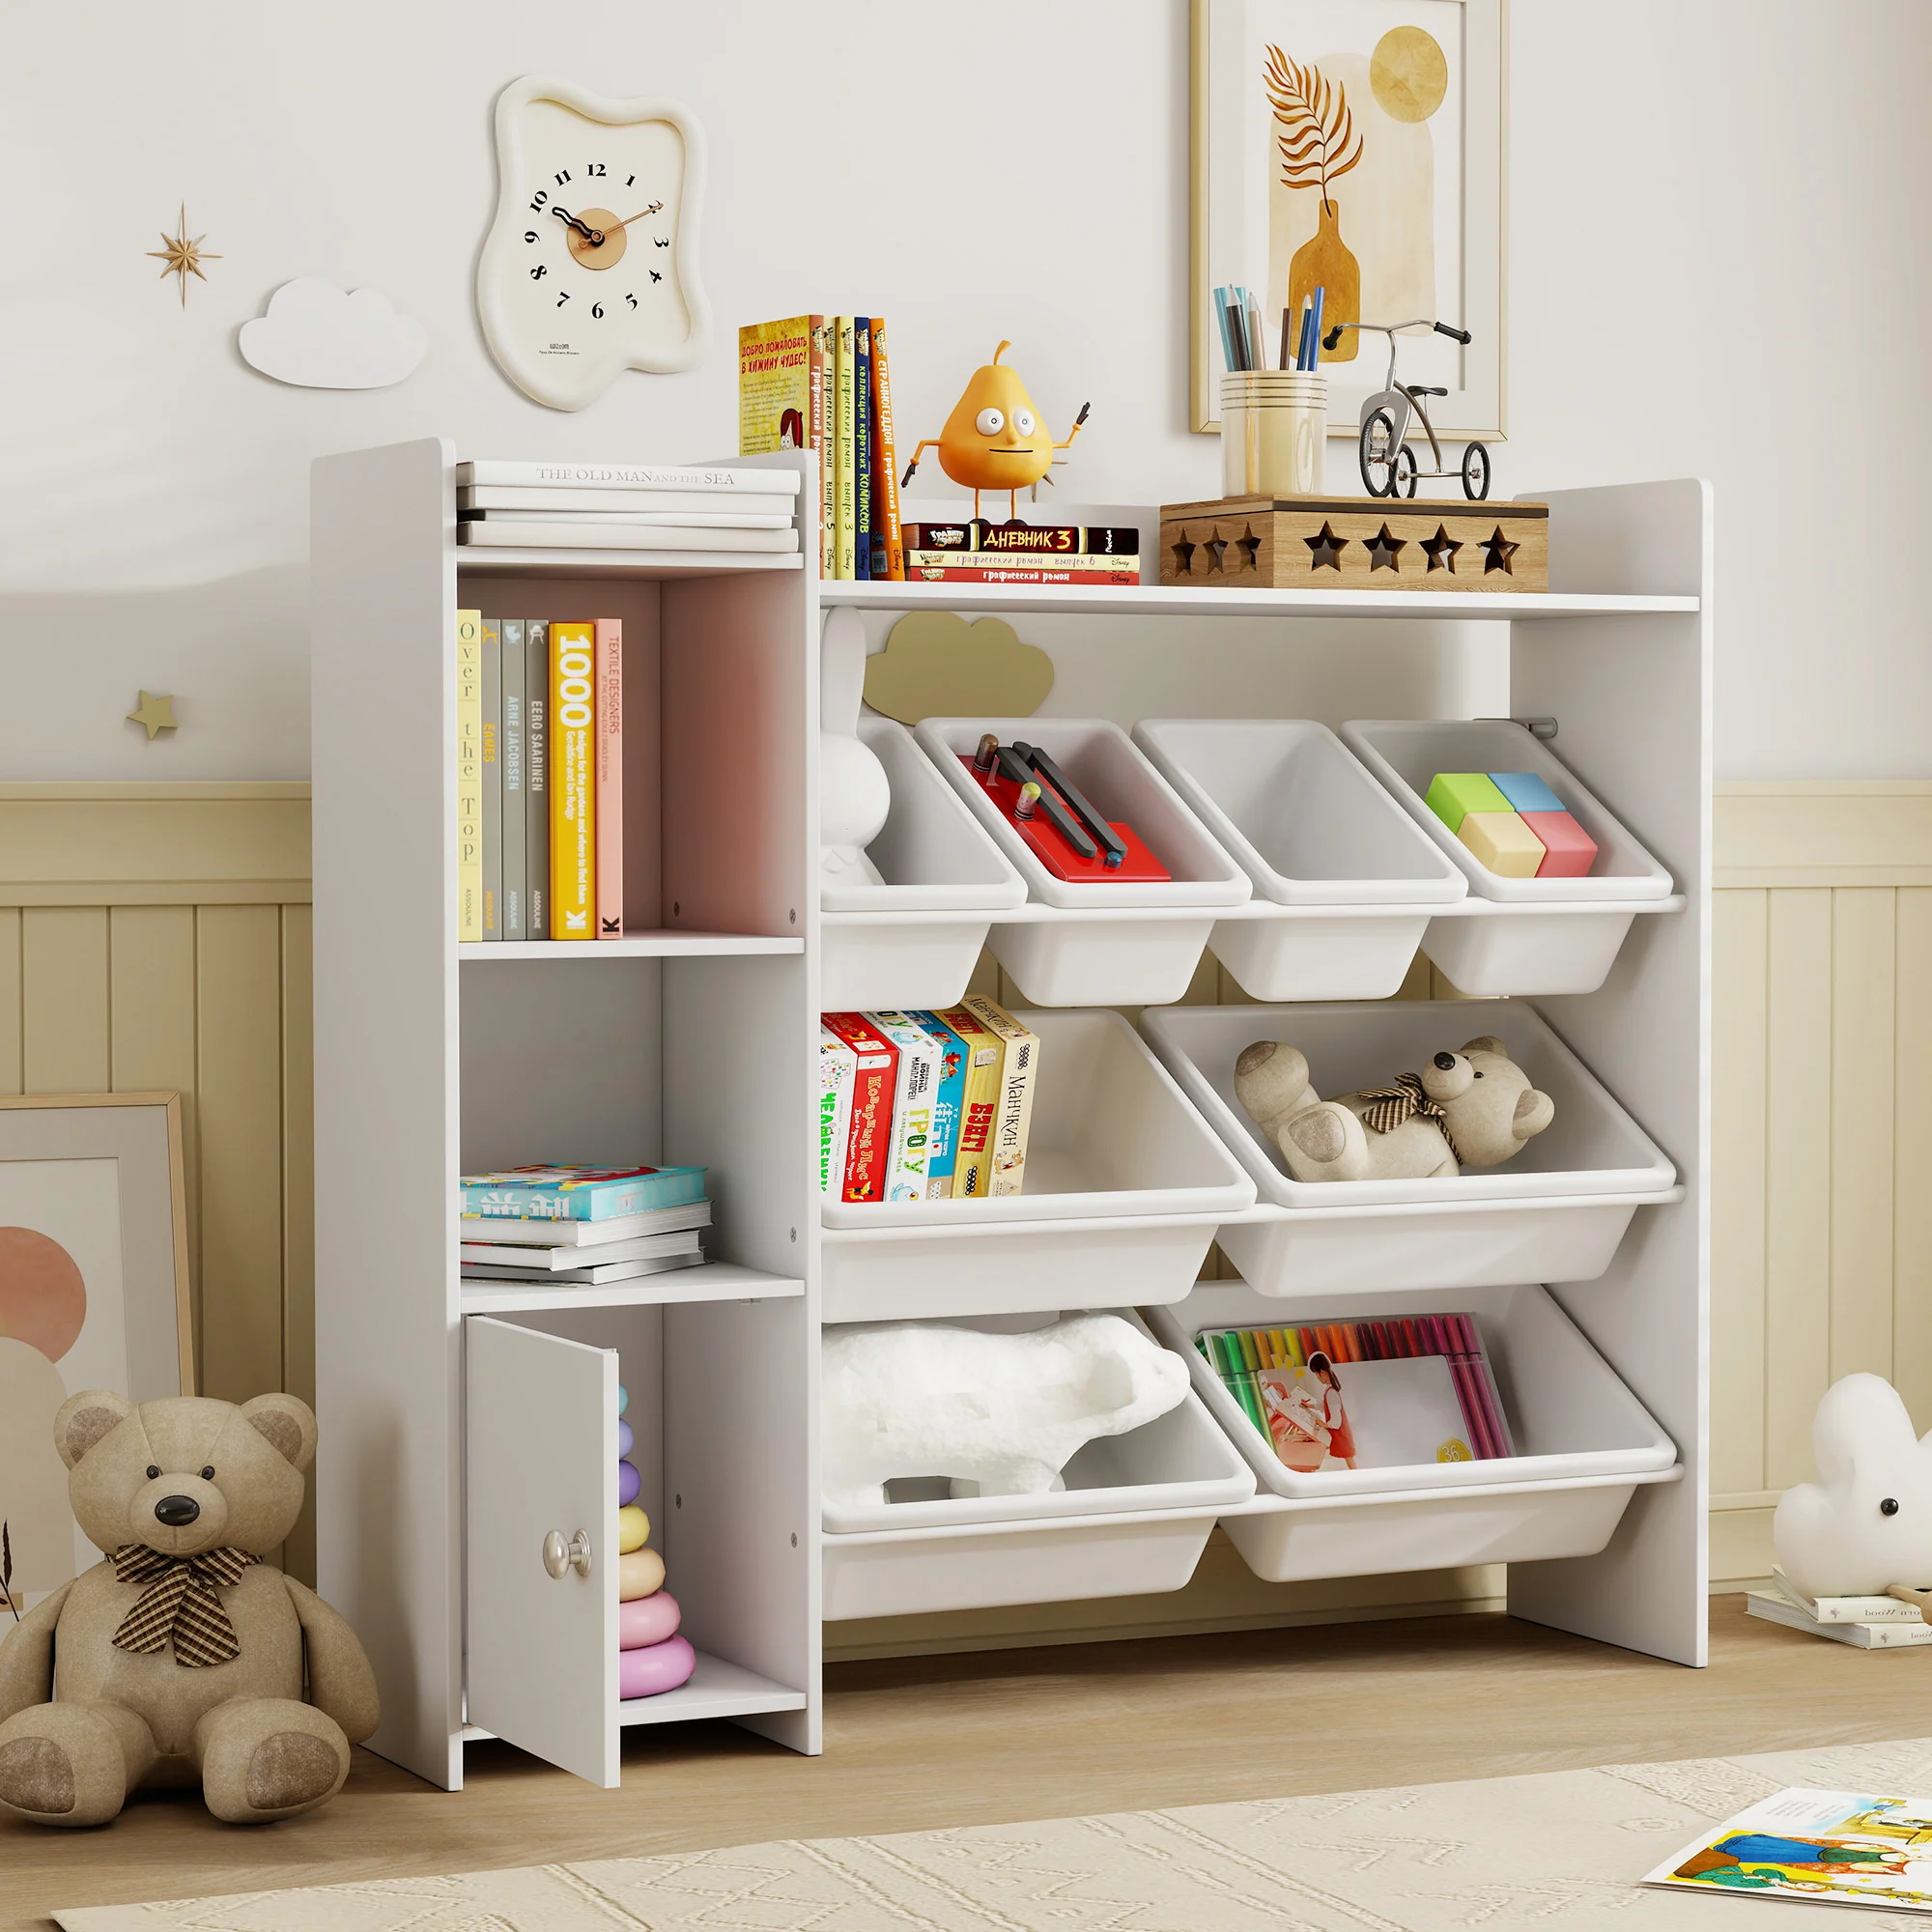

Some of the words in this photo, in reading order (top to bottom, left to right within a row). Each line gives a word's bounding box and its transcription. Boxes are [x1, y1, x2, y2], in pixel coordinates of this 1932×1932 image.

[554, 169, 572, 186] 11
[586, 163, 607, 177] 12
[624, 174, 636, 187] 1
[528, 190, 549, 214] 10
[525, 230, 541, 243] 9
[653, 236, 669, 248] 3
[529, 265, 548, 281] 8
[648, 269, 663, 284] 4
[556, 291, 571, 308] 7
[591, 300, 604, 320] 6
[625, 293, 638, 311] 5
[741, 343, 763, 358] ДОБРО
[765, 336, 808, 353] ПОЖАЛОВАТЬ
[741, 361, 747, 375] В
[748, 355, 779, 374] ХИЖИНУ
[781, 351, 808, 368] ЧУДЕС!
[858, 365, 867, 419] коллекция
[878, 359, 894, 445] СТРАННОГЕДДОН
[857, 422, 867, 469] коротких
[536, 468, 572, 481] THE
[576, 469, 611, 482] OLD
[616, 470, 653, 483] MAN
[654, 473, 677, 483] AND
[680, 474, 700, 484] THE
[704, 472, 734, 485] SEA
[859, 472, 869, 533] КОМИКСОВ
[826, 522, 836, 530] 5
[983, 529, 1052, 549] ДНЕВНИК
[1057, 530, 1071, 550] 3
[460, 622, 474, 697] Over
[609, 637, 619, 676] TEXTILE
[559, 634, 592, 728] 1000
[507, 696, 520, 727] ARNE
[531, 700, 543, 730] EERO
[609, 679, 620, 735] DESIGNERS
[463, 723, 473, 777] the
[483, 724, 496, 763] EAMES
[507, 731, 520, 790] JACOBSEN
[531, 733, 544, 791] SAARINEN
[462, 798, 475, 862] Top
[859, 1075, 882, 1149] Коварный
[1001, 1075, 1026, 1147] Манчкин
[904, 1108, 930, 1175] ГРОГУ
[960, 1102, 994, 1153] БЭНГ!
[856, 1150, 874, 1180] Лис
[1442, 1445, 1461, 1463] 36
